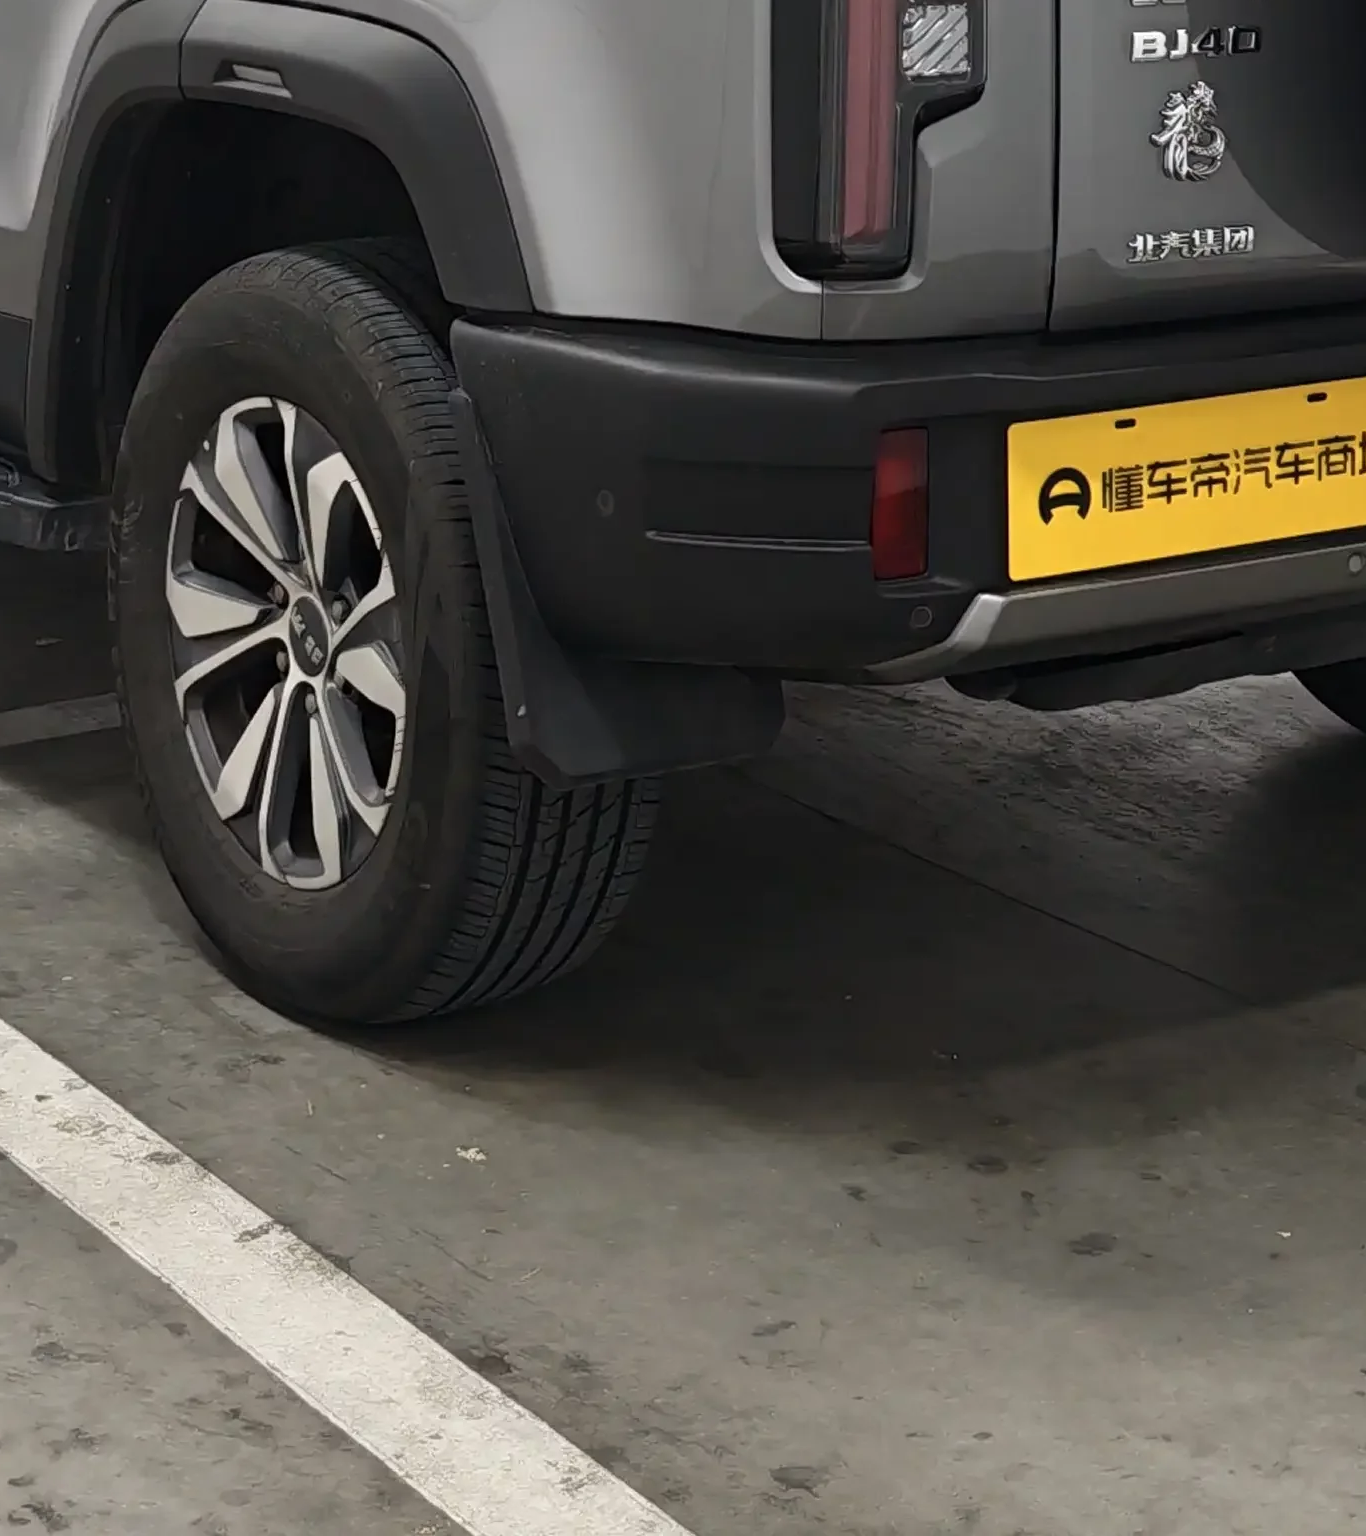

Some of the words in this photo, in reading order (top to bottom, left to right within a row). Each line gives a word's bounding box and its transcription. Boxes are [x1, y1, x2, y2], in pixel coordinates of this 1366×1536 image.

[1131, 25, 1262, 64] BJ40
[1127, 224, 1256, 263] 北汽集团
